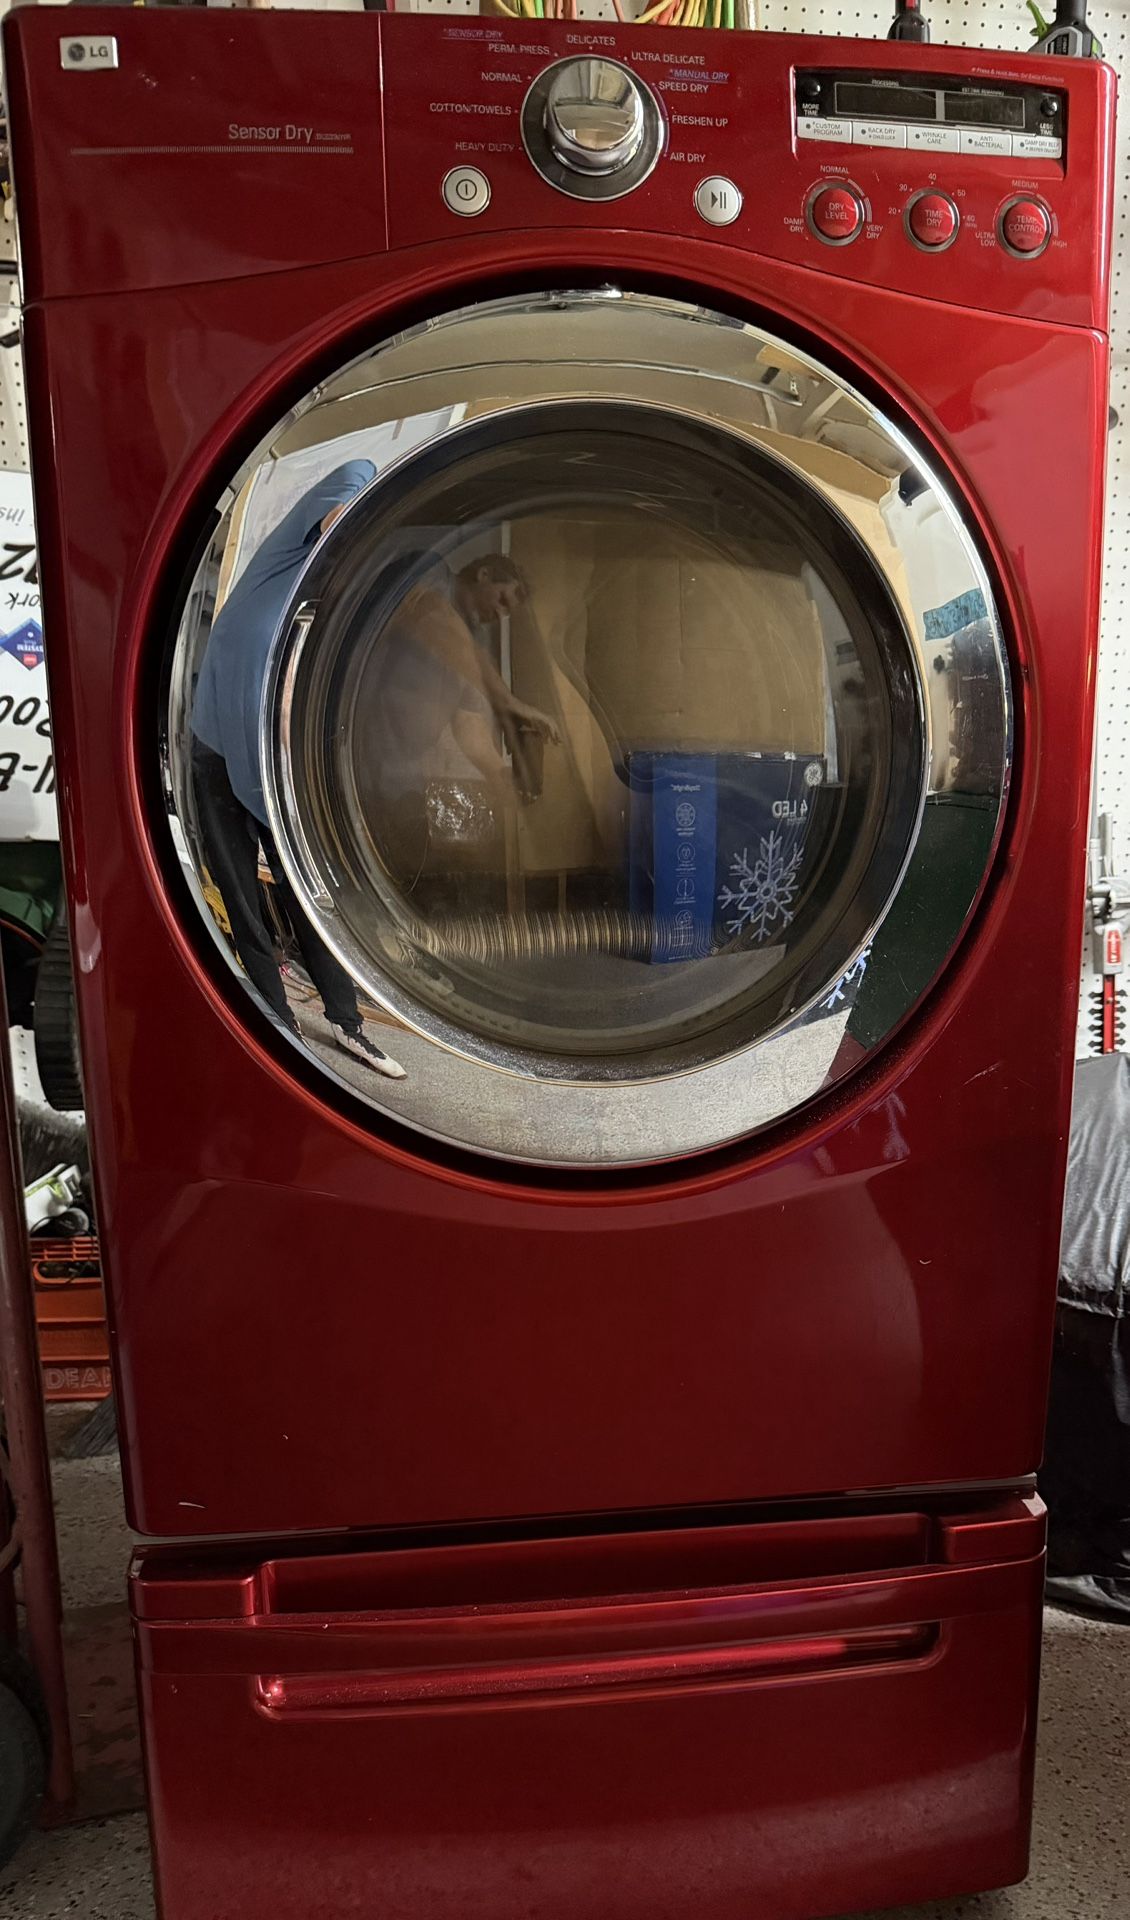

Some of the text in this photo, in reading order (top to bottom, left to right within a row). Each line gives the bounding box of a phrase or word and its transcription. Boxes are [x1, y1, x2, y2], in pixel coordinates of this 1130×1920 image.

[567, 34, 616, 46] DELICATES
[90, 46, 108, 57] LG
[520, 45, 550, 55] PRESS
[631, 52, 705, 65] ULTRA DELICATE
[481, 72, 522, 83] NORMAL
[712, 71, 730, 81] DRY
[659, 81, 709, 94] SPEED DRY
[672, 115, 728, 128] FRESHEN UP
[815, 122, 841, 130] CUSTOM
[229, 124, 280, 140] Sensor
[285, 124, 313, 144] Dry
[868, 127, 884, 135] RACK
[922, 131, 947, 139] WRINKLE
[927, 137, 942, 145] CARE
[974, 141, 1004, 150] BACTERIAL
[456, 142, 514, 152] HEAVY DUTY
[670, 152, 706, 163] AIR DRY
[820, 165, 849, 174] NORMAL
[1011, 180, 1039, 189] MEDIUM
[828, 202, 845, 211] DRY
[888, 207, 897, 215] 20
[825, 211, 849, 220] LEVEL
[925, 210, 944, 218] TIME
[783, 217, 804, 225] DAMP
[926, 218, 942, 227] DRY
[790, 225, 804, 233] DRY
[1008, 225, 1043, 234] CONTROL
[866, 231, 880, 240] DRY
